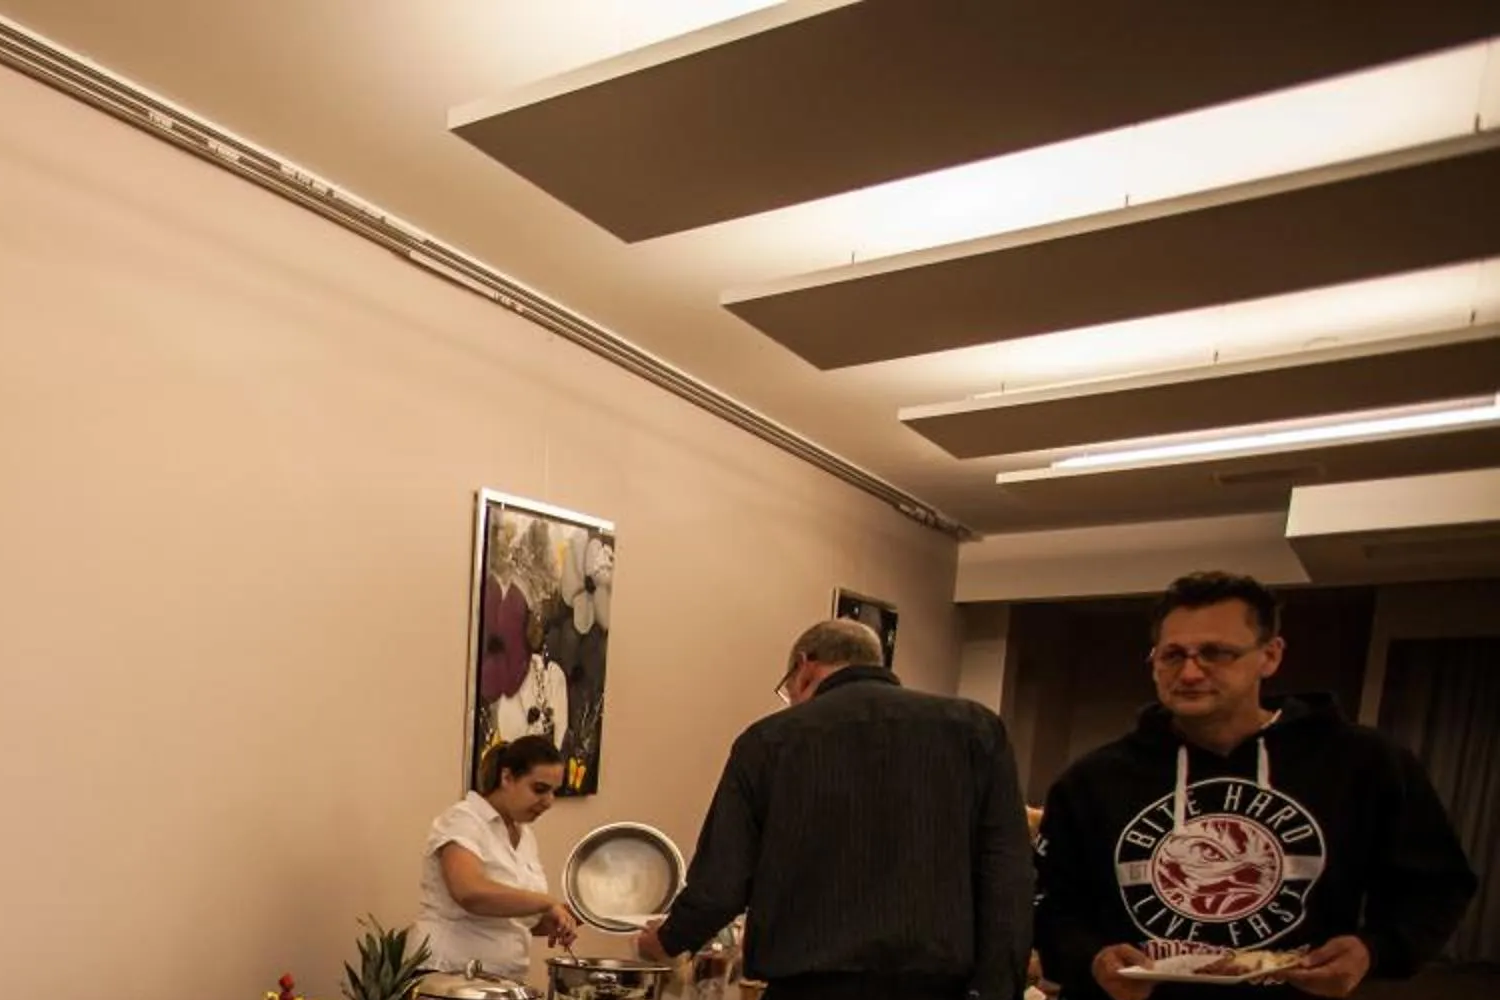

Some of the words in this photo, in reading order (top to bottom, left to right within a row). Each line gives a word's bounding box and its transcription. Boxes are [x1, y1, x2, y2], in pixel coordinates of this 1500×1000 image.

[1125, 791, 1201, 849] BITE
[1222, 783, 1314, 844] HARD
[1132, 894, 1202, 942] LIVE
[1228, 884, 1302, 947] FAST
